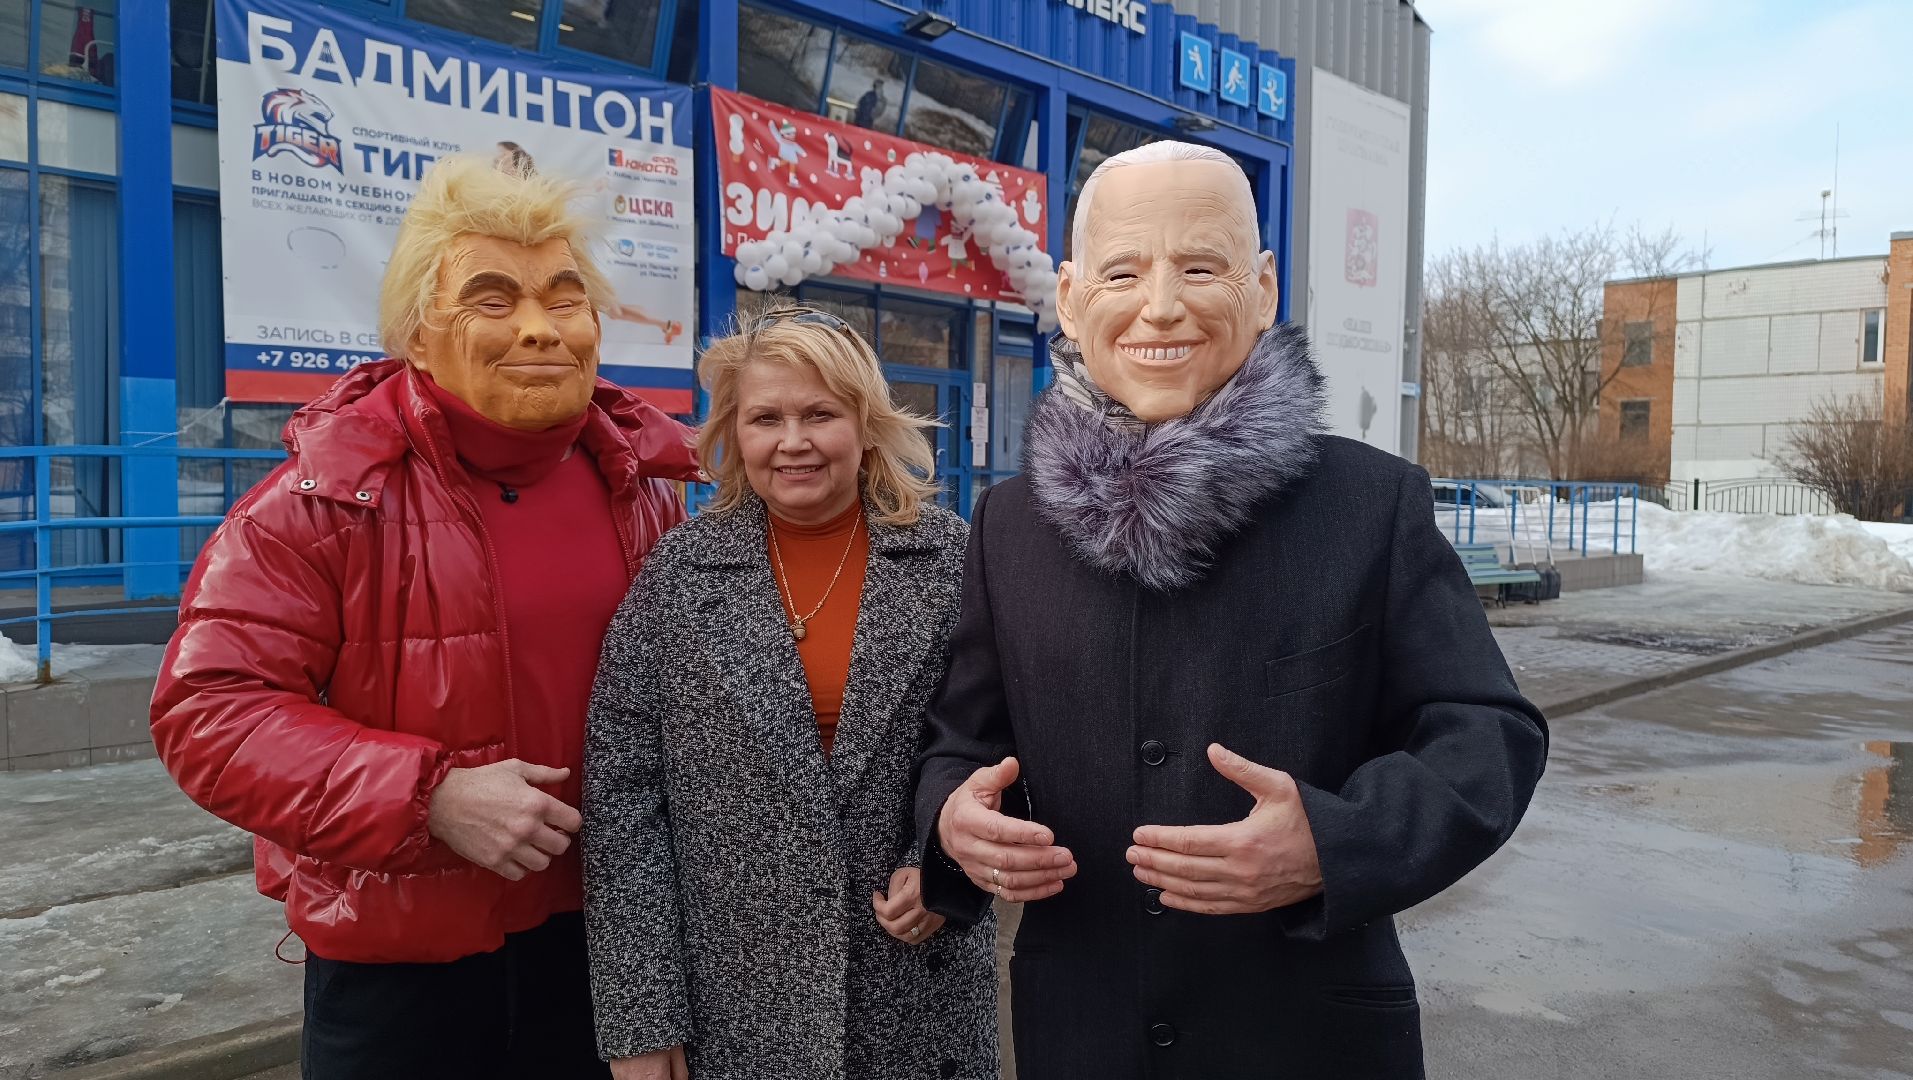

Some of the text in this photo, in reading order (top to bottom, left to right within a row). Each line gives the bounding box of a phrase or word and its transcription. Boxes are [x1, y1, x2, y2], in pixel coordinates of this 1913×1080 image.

[247, 11, 674, 147] БАДМИНТОН
[256, 124, 340, 166] TIGER
[352, 126, 461, 152] СПОРТИВНЫЙ КЛУБ
[353, 142, 442, 181] ТИГ
[625, 159, 678, 176] ЮНОСТЬ
[252, 169, 262, 181] В
[268, 171, 332, 191] НОВОМ
[252, 186, 333, 205] ПРИГЛАШАЕМ
[345, 200, 392, 213] СЕКЦИЮ
[252, 198, 282, 210] ВСЕХ
[286, 203, 356, 221] ЖЕЛАЮЩИХ
[629, 197, 674, 218] ЦСКА
[257, 325, 335, 344] ЗАПИСЬ
[340, 331, 351, 344] В
[256, 350, 284, 368] +7
[289, 351, 330, 369] 926
